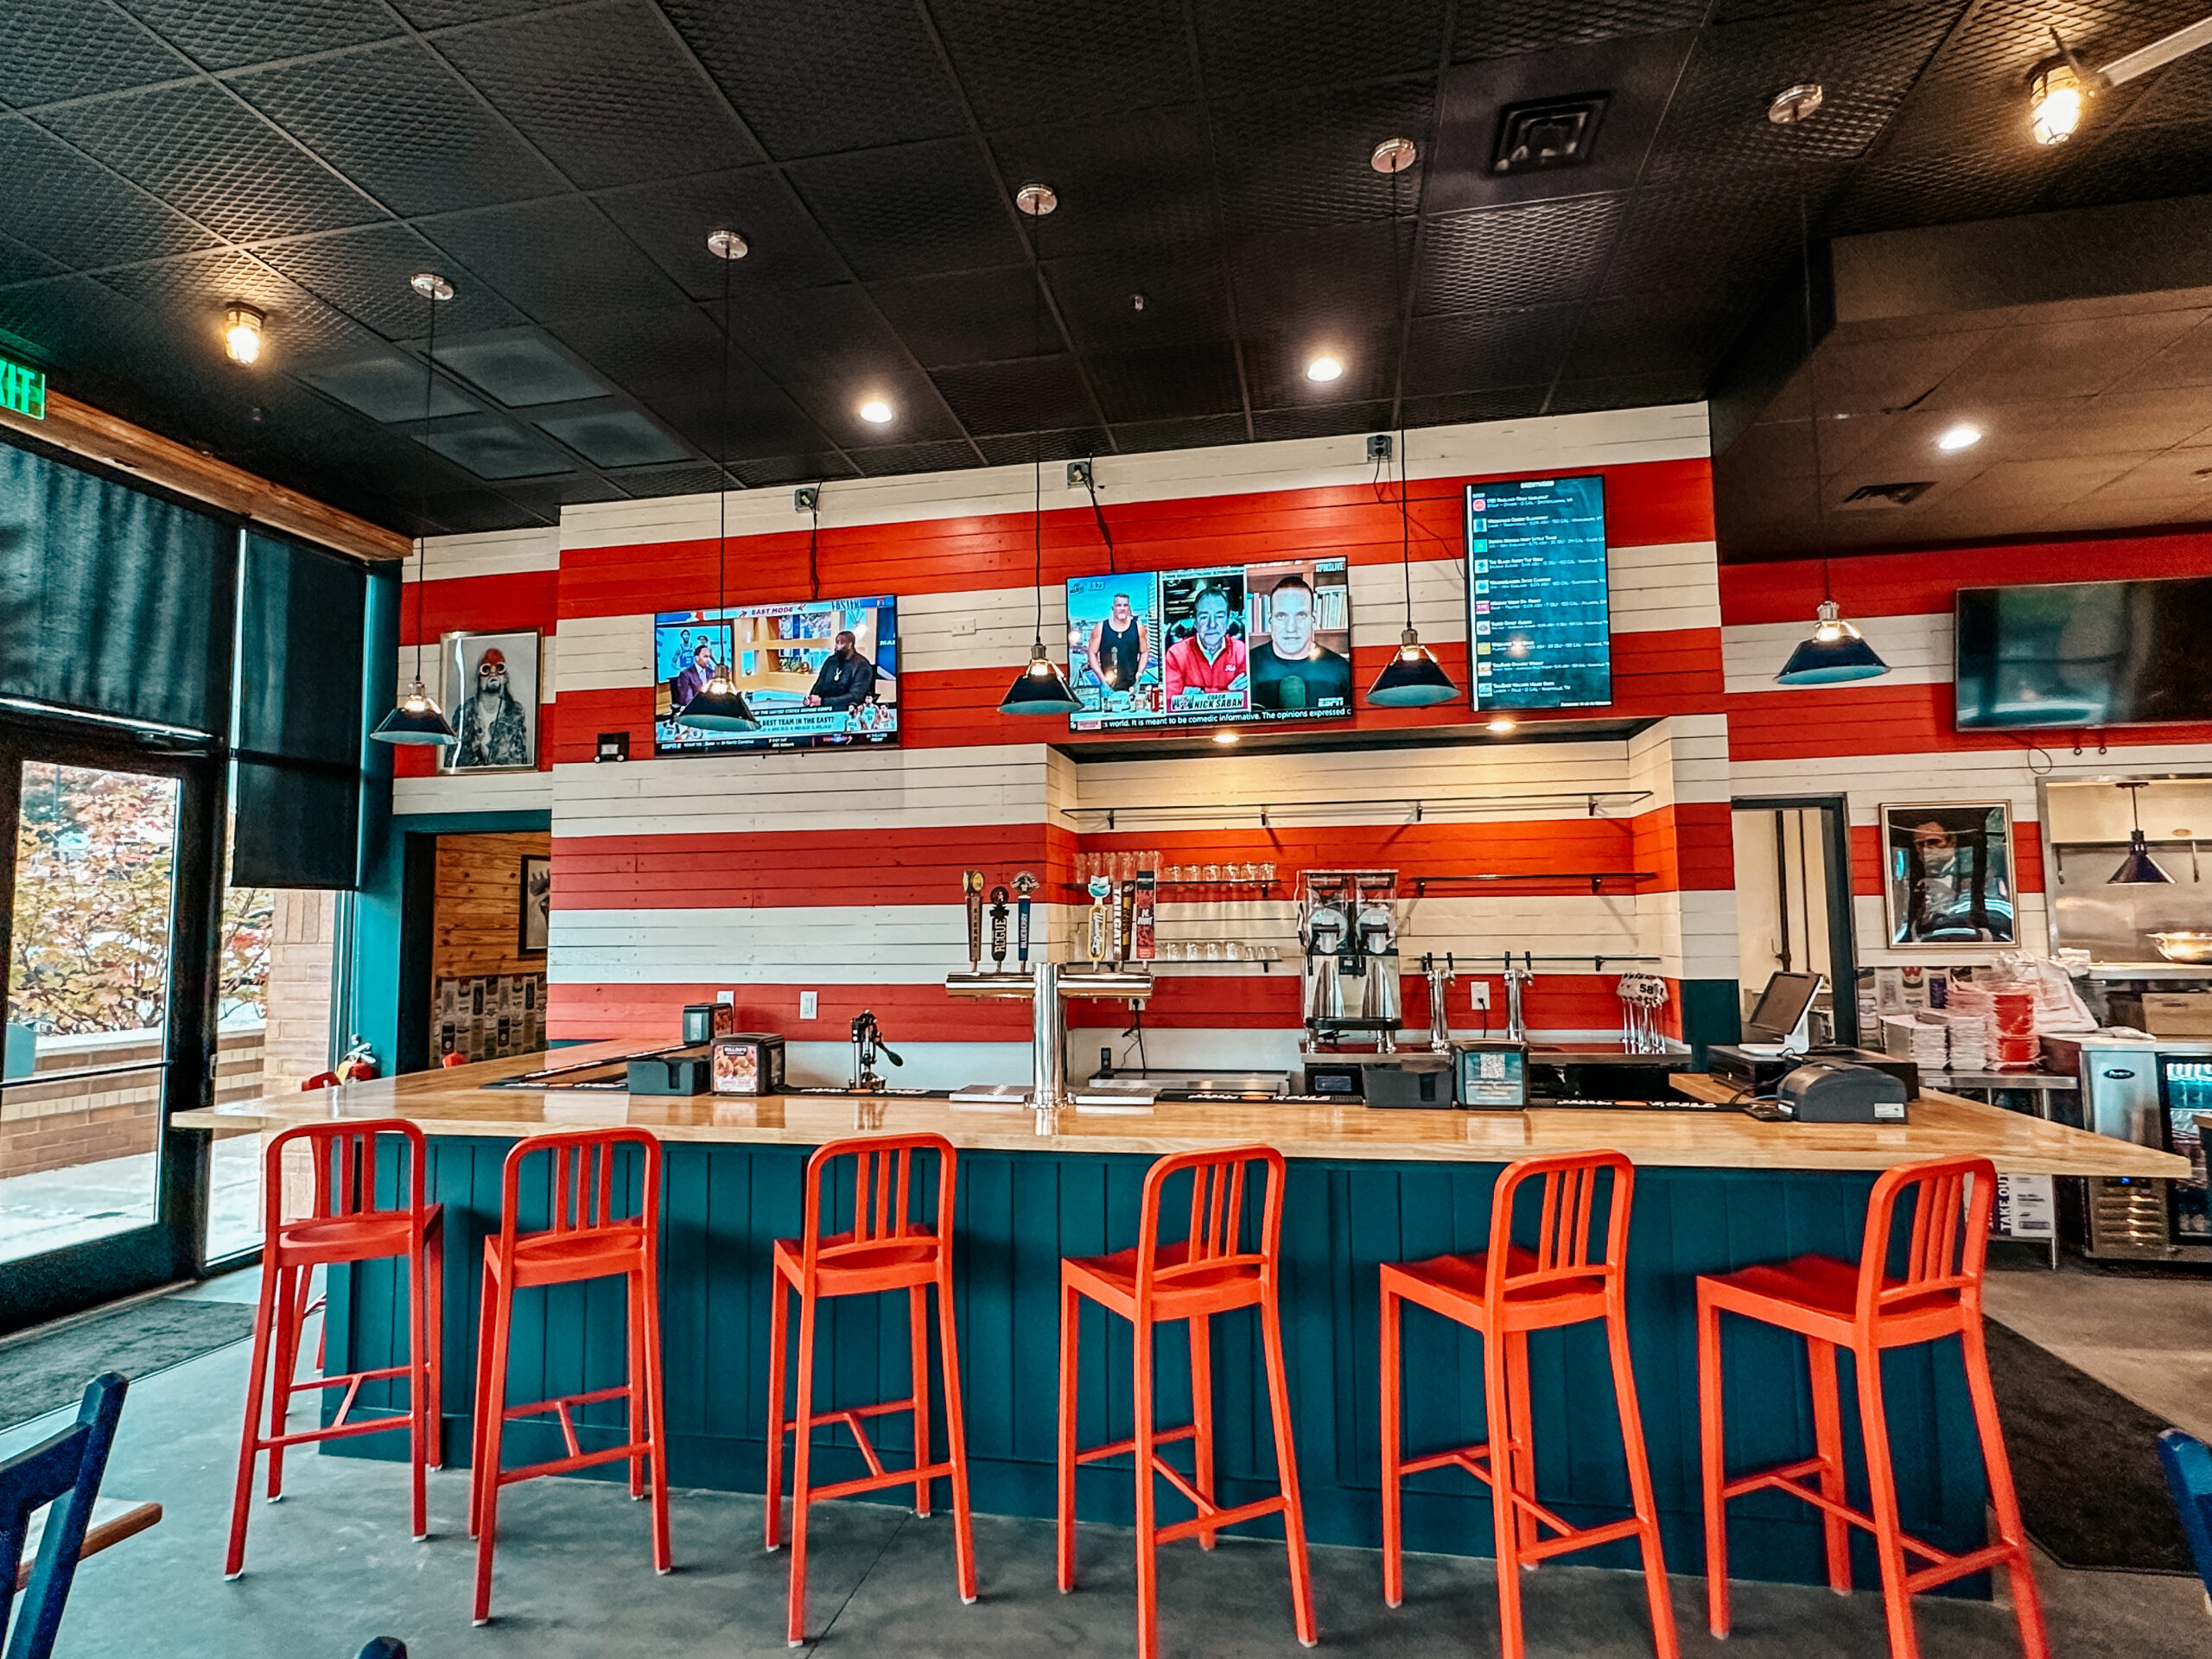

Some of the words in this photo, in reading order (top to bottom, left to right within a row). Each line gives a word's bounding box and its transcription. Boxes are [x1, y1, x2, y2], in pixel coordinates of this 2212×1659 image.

[0, 359, 35, 413] XIT
[1194, 700, 1214, 709] NICK
[1216, 698, 1243, 708] SABAN
[1318, 697, 1344, 707] ESPN
[1177, 715, 1187, 724] be
[1188, 715, 1218, 723] comedic
[1262, 711, 1275, 720] The
[1277, 709, 1308, 721] opinions
[1309, 708, 1345, 719] expressed
[1113, 887, 1122, 955] TAILGATE
[995, 918, 1006, 953] ROGUE
[1639, 983, 1654, 995] 58
[2000, 1200, 2012, 1230] TAKE
